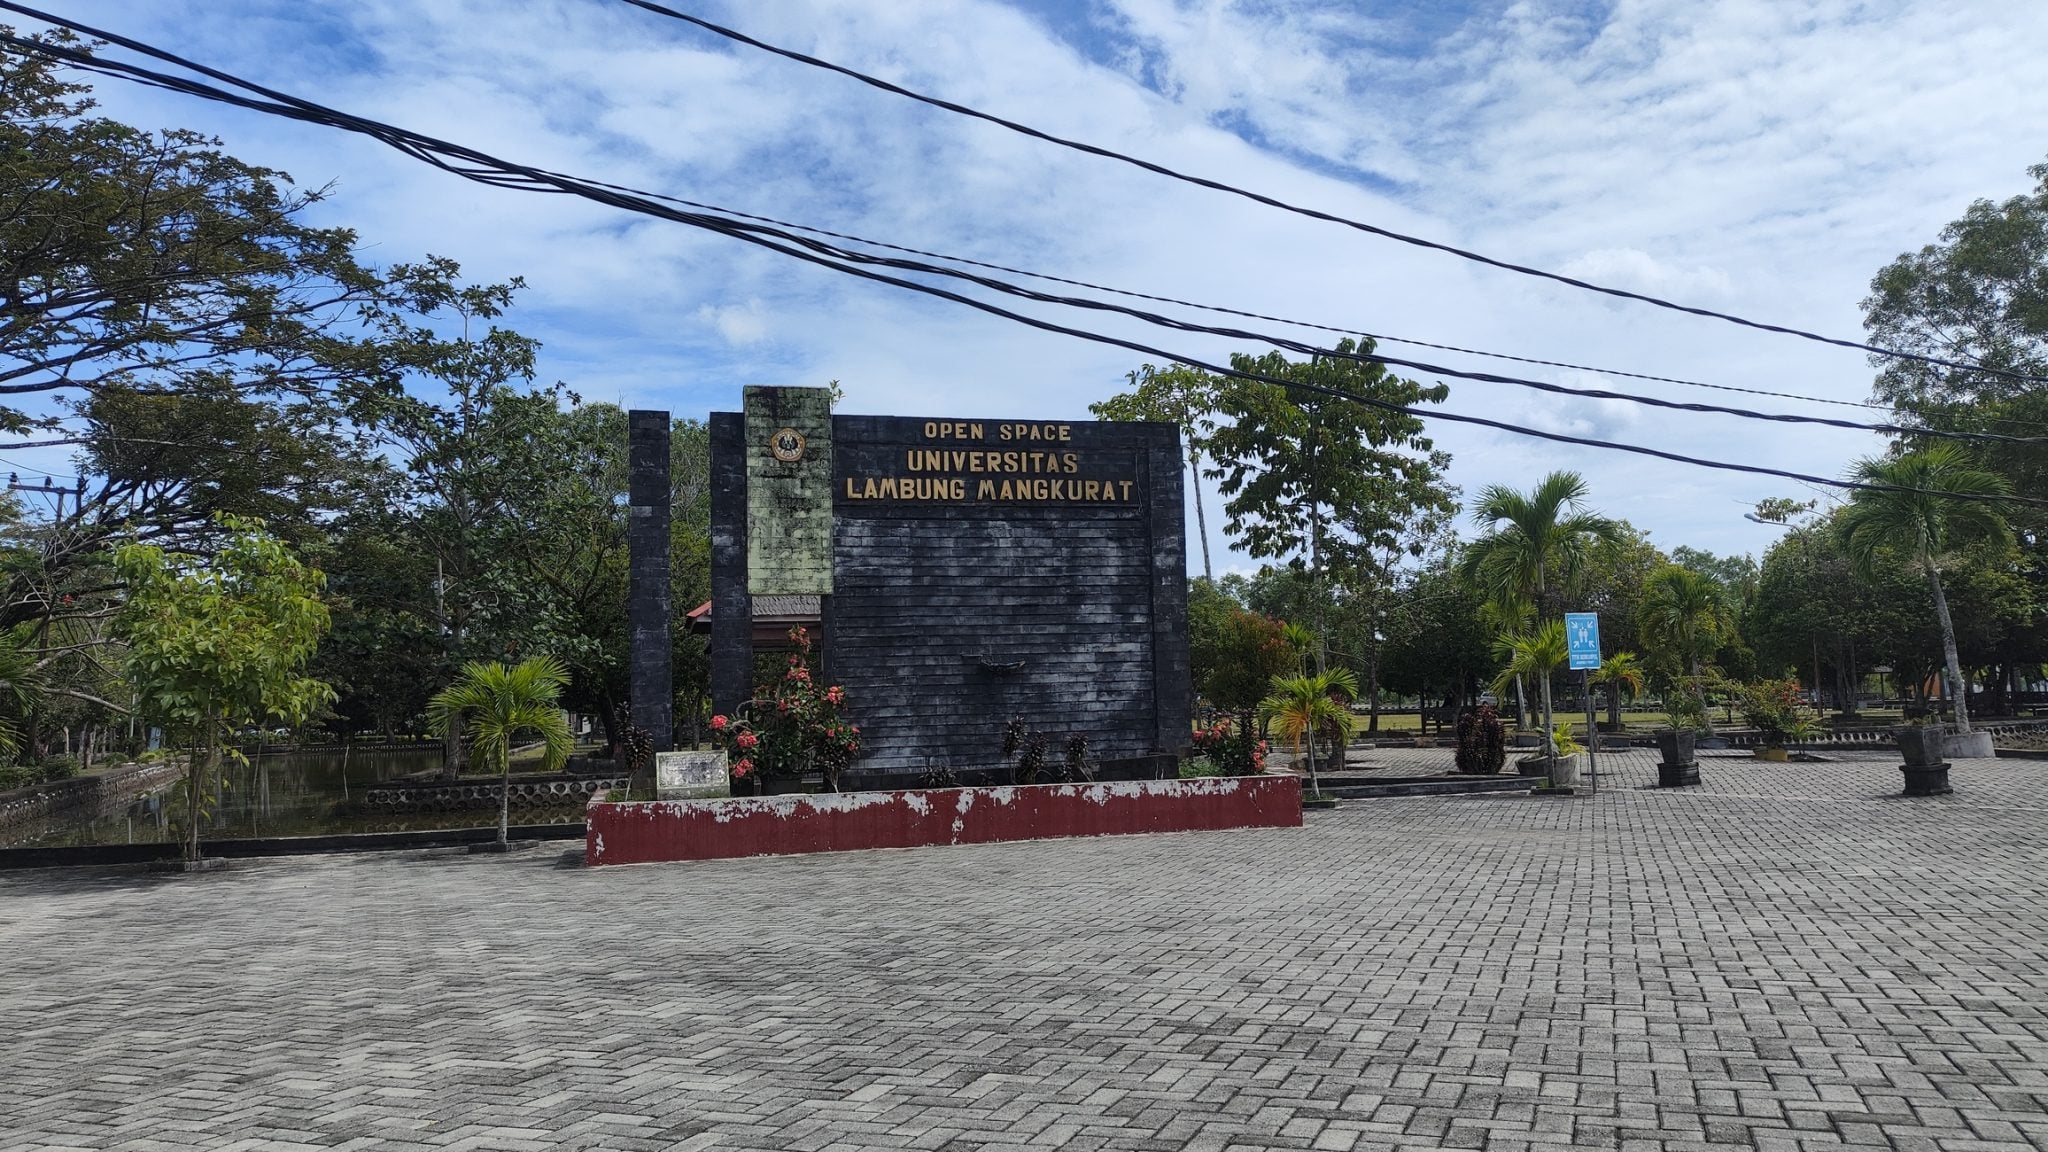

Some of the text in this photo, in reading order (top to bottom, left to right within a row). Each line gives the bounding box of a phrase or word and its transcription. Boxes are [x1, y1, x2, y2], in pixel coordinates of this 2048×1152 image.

[924, 422, 1071, 441] OPEN SPACE
[907, 450, 1078, 473] UNIVERSITAS
[847, 478, 1133, 501] LAMBUNG MANGKURAT
